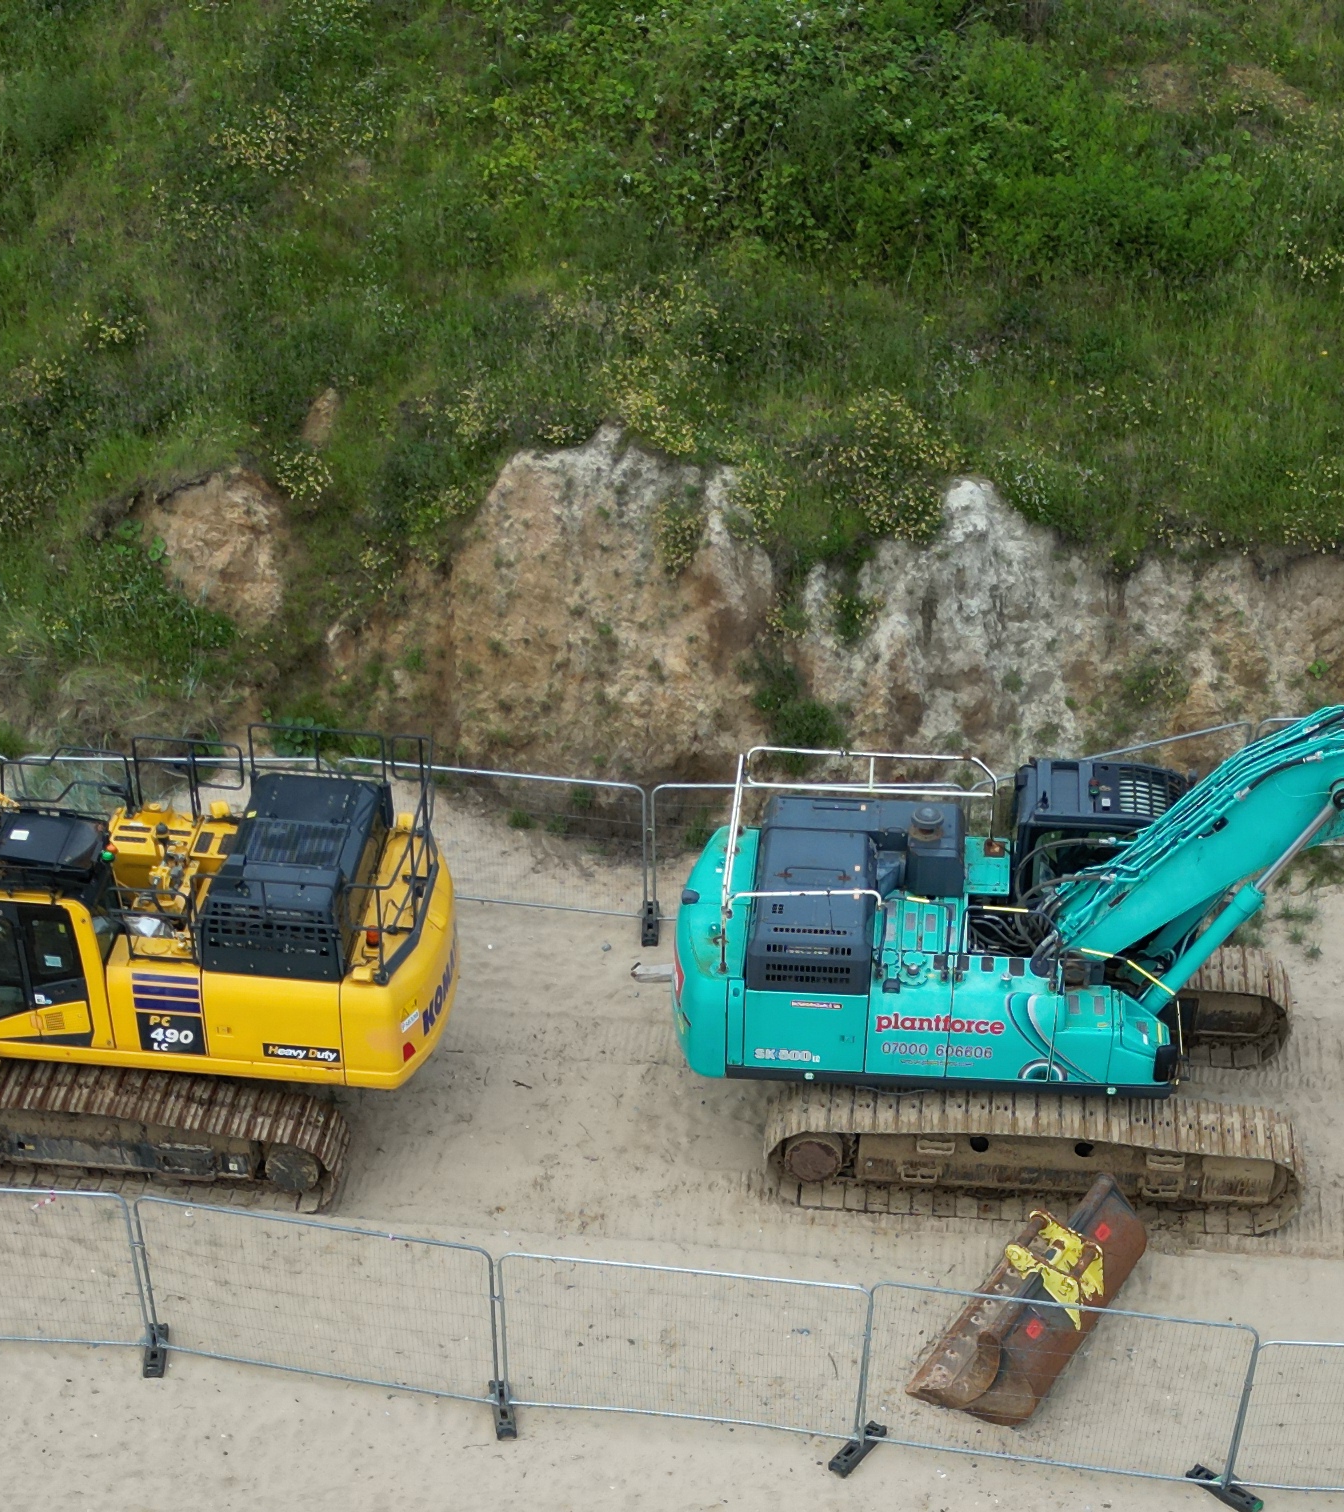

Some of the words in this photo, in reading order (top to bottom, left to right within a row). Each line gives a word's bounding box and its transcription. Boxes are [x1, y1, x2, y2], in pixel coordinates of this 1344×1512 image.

[149, 1016, 171, 1027] PC
[875, 1012, 1005, 1035] plantforce
[151, 1028, 194, 1044] 490
[153, 1043, 168, 1051] LC
[268, 1046, 306, 1059] Heavy
[308, 1049, 337, 1062] Duty
